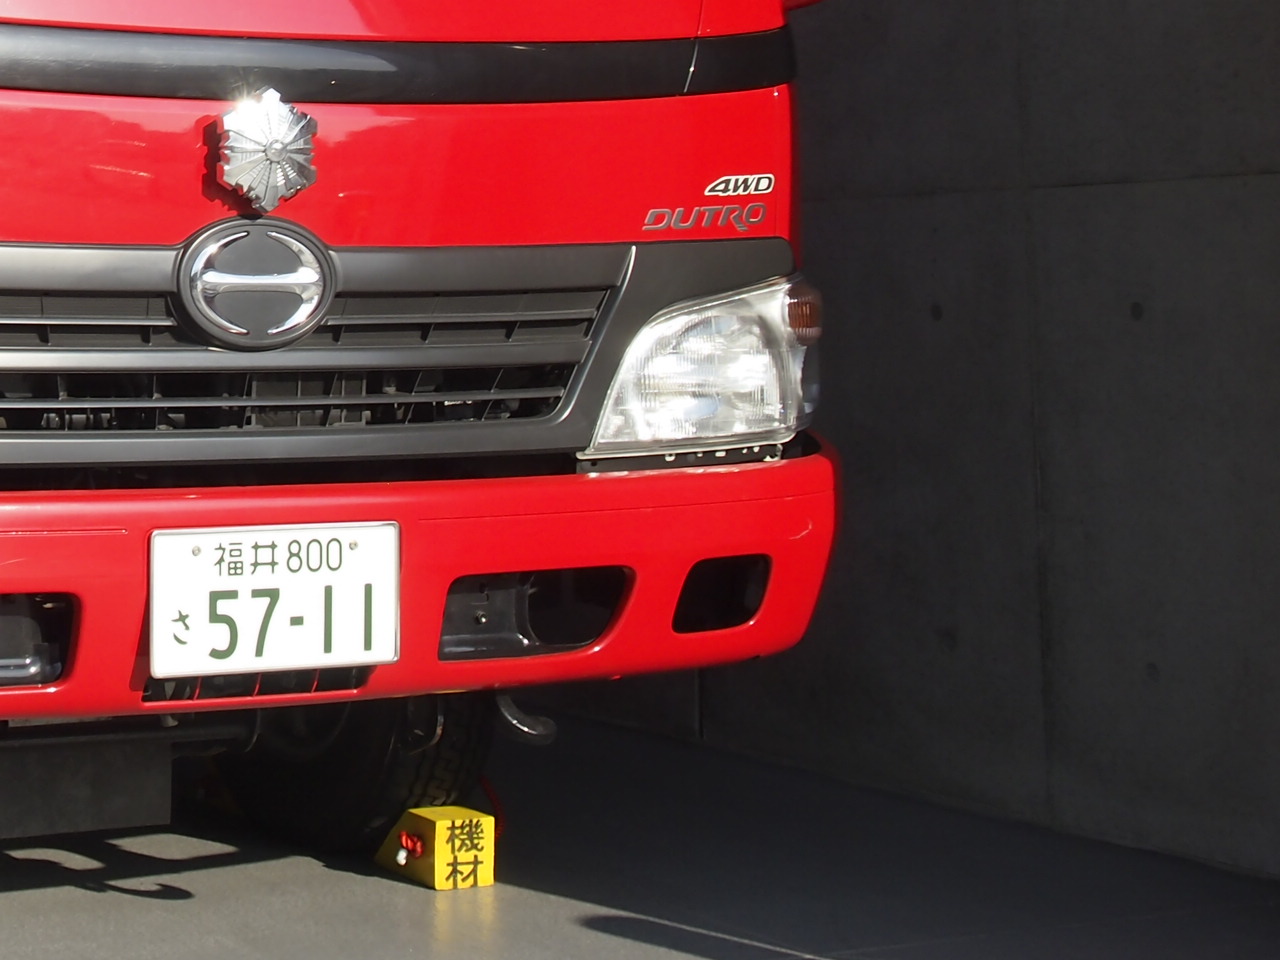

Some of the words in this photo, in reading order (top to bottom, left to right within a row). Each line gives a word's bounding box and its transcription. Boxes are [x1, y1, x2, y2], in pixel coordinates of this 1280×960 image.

[705, 174, 775, 196] 4WD
[642, 202, 767, 232] DUTRO
[171, 609, 190, 645] さ
[208, 583, 373, 660] 57-11
[445, 818, 485, 889] 機材
